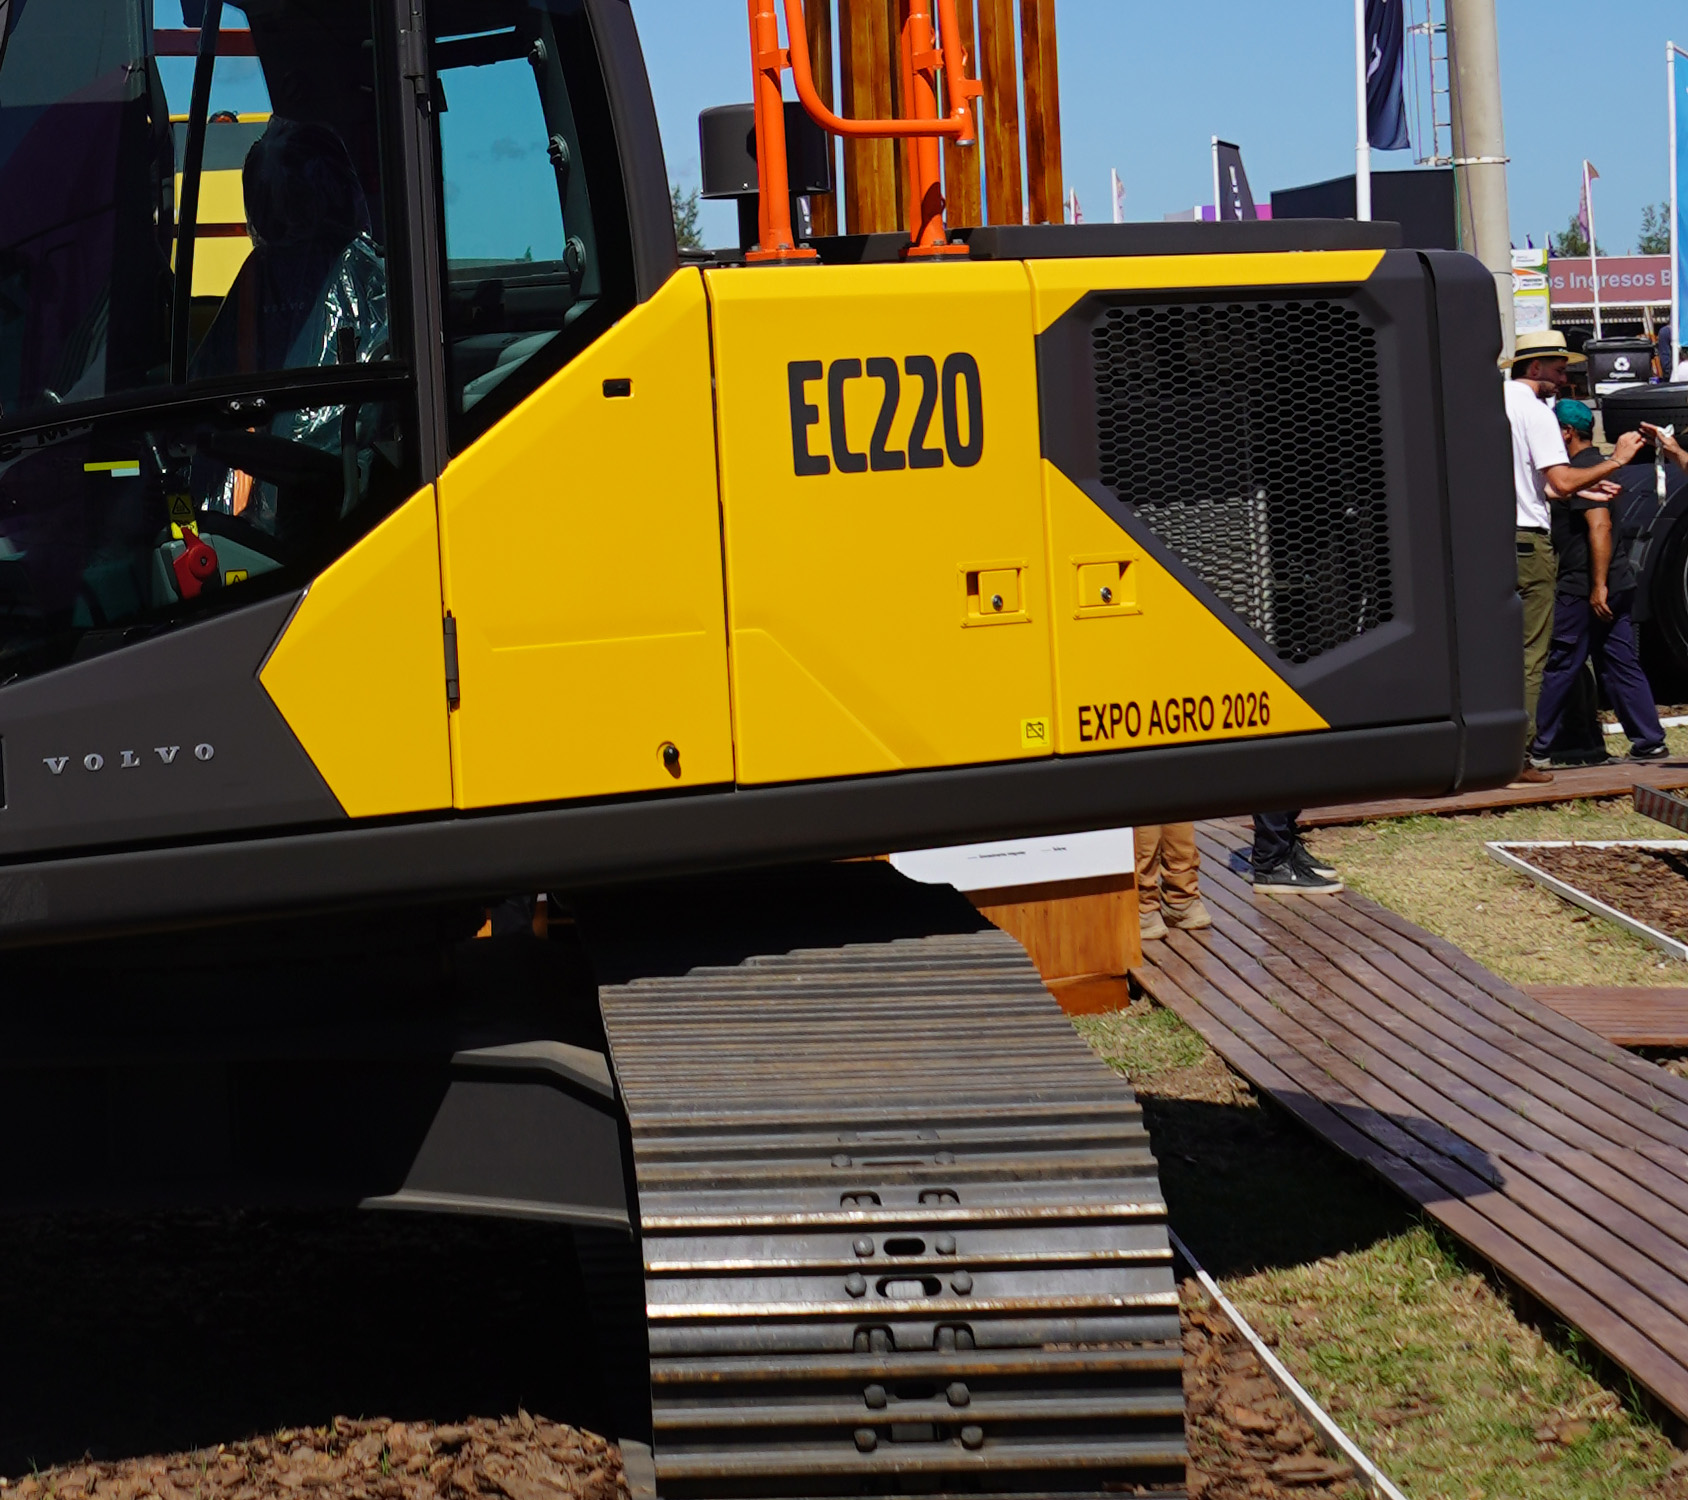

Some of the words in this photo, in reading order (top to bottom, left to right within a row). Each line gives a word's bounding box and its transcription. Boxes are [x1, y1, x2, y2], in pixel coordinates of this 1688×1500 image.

[787, 352, 984, 477] EC220
[1078, 702, 1142, 743] EXPO
[1148, 695, 1215, 737] AGRO
[1222, 691, 1271, 731] 2026
[42, 743, 216, 775] VOLVO
